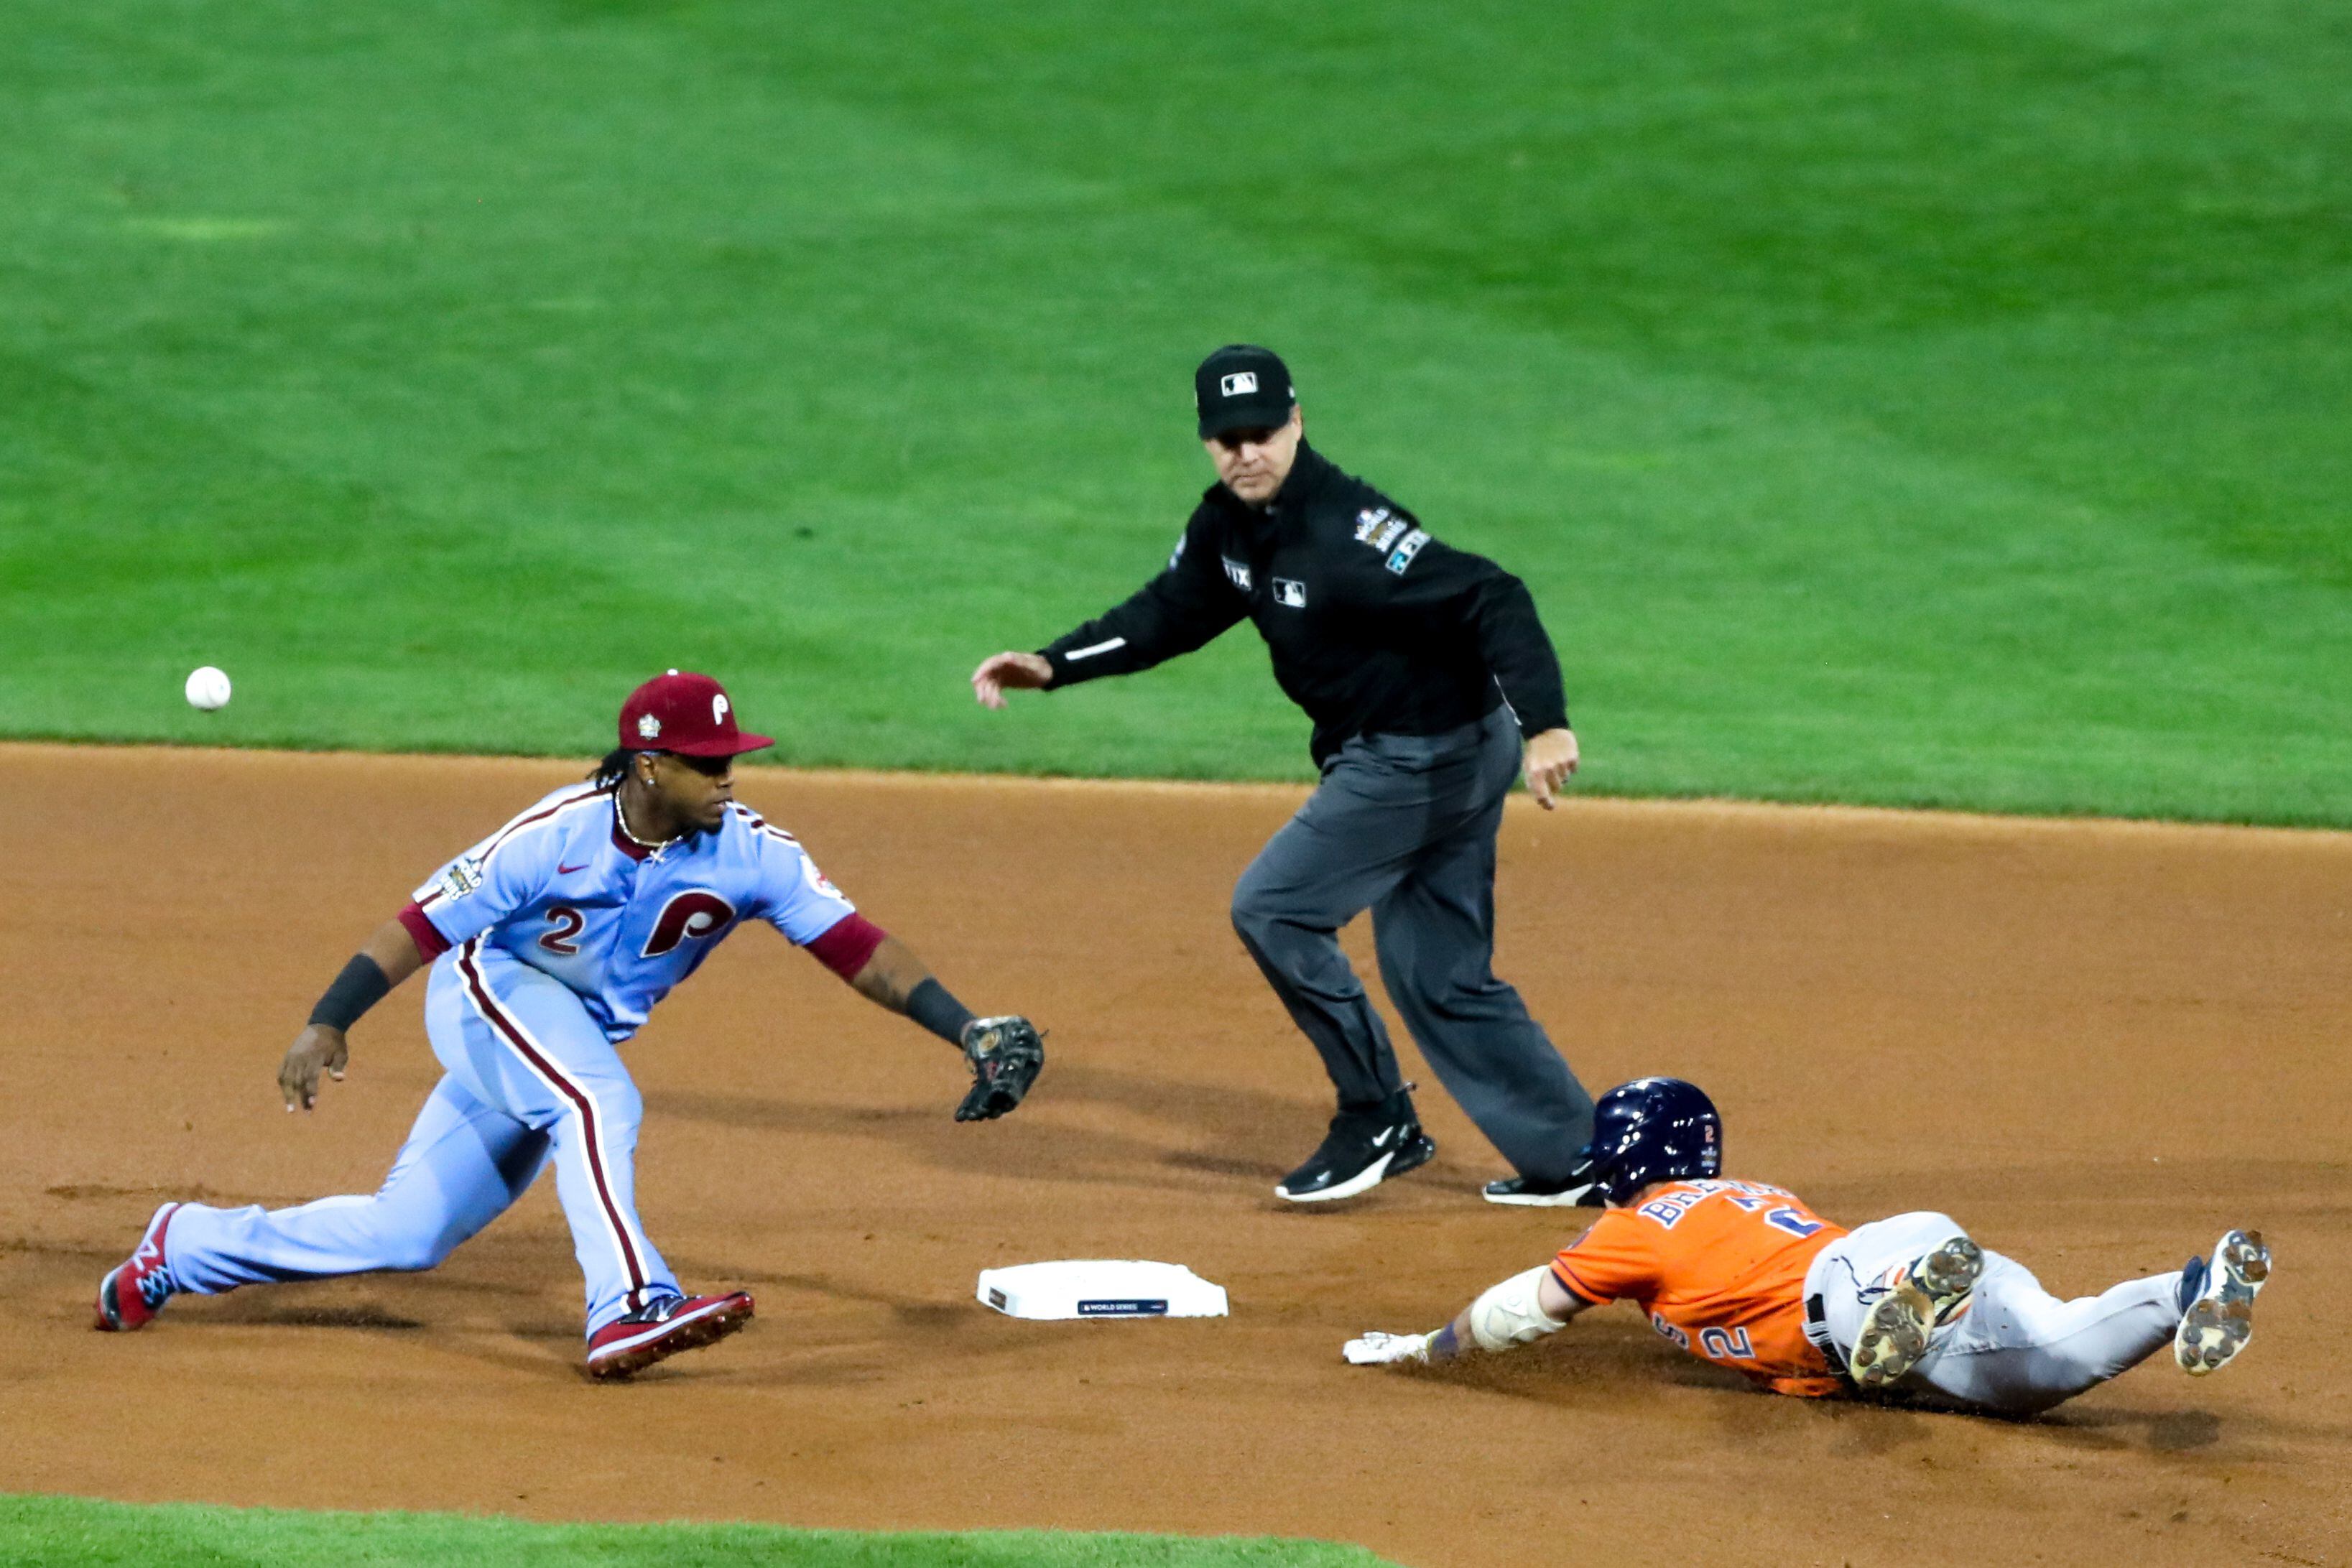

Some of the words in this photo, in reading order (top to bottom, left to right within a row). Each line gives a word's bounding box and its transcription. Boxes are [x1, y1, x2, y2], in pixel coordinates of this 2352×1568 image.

[712, 694, 728, 725] P
[540, 906, 586, 955] 2
[639, 888, 736, 959] P
[1705, 1124, 1715, 1143] 2
[1091, 1303, 1116, 1312] WORLD
[1699, 1327, 1756, 1359] 2
